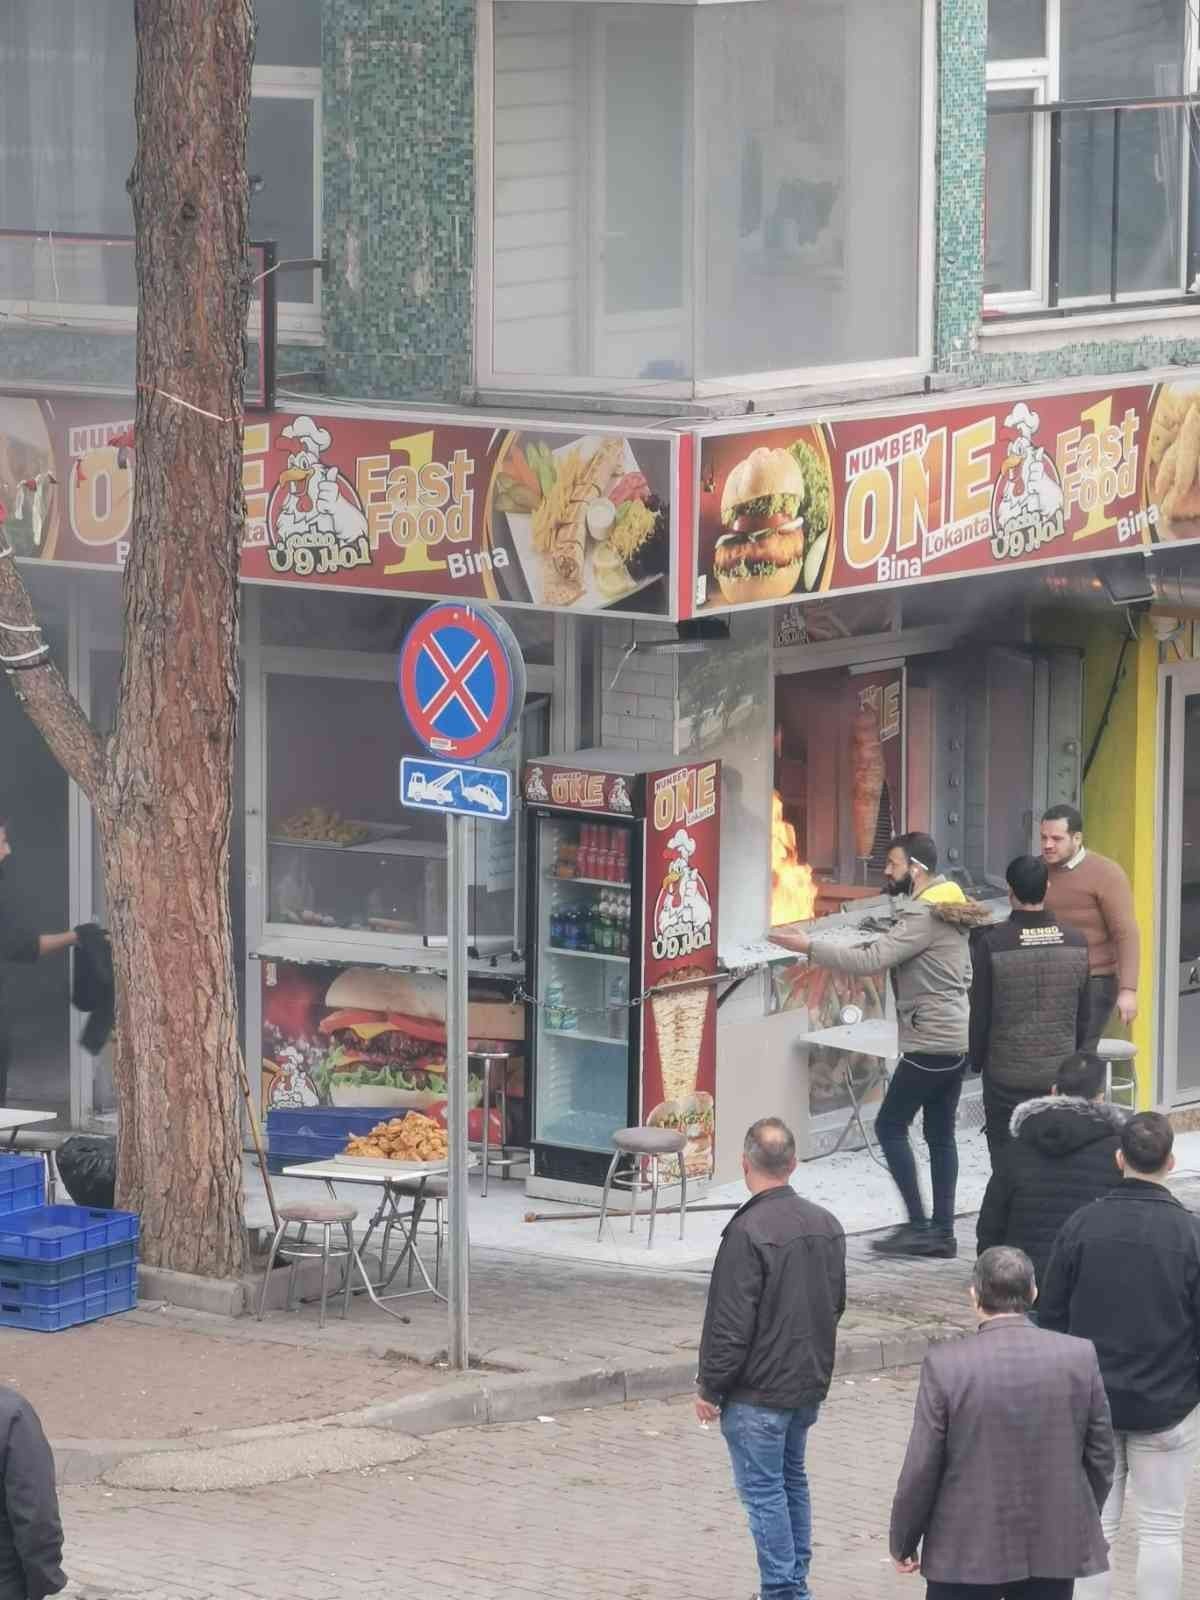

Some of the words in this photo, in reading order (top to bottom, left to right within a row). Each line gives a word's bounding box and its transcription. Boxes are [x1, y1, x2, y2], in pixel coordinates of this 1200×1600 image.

[848, 427, 925, 476] NUMBER
[1056, 408, 1140, 477] Fast
[356, 449, 475, 508] Fast
[843, 416, 996, 569] ONE
[1063, 444, 1139, 521] Food
[366, 491, 474, 550] Food
[925, 514, 990, 557] Lokanta
[1116, 503, 1160, 543] Bina
[447, 546, 510, 580] Bina
[876, 555, 922, 583] Bina
[551, 774, 606, 804] ONE
[654, 762, 716, 831] ONE
